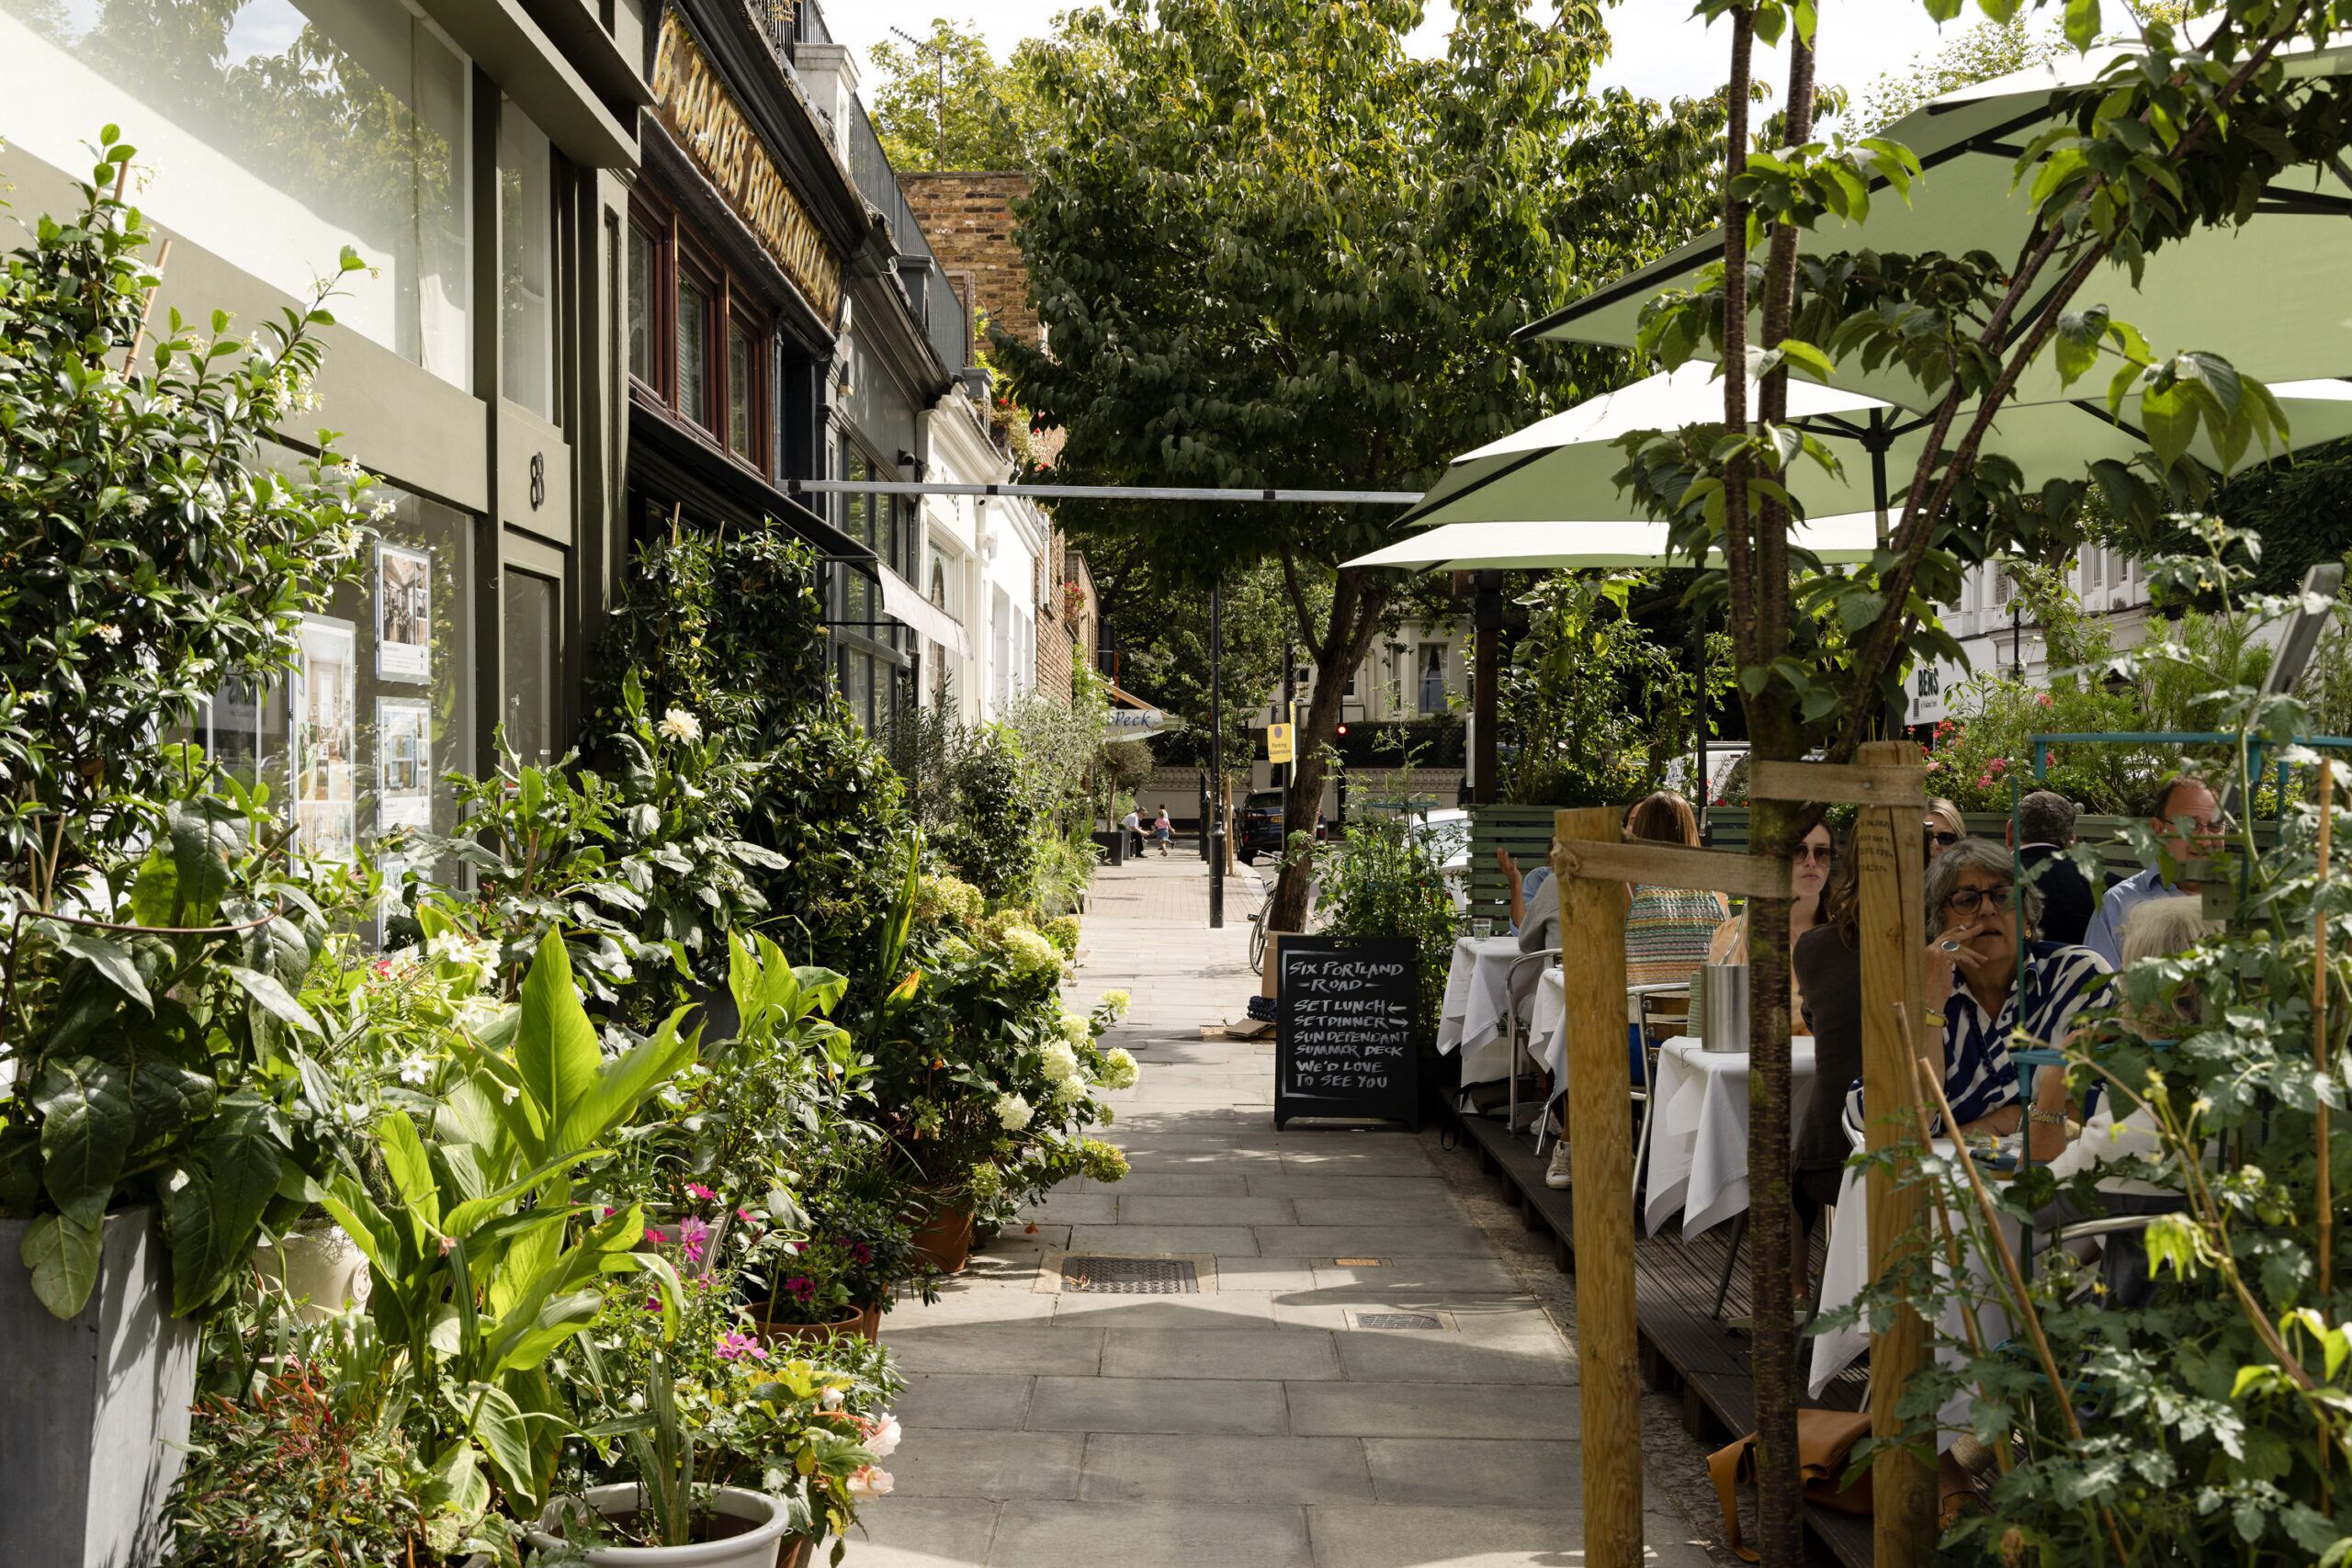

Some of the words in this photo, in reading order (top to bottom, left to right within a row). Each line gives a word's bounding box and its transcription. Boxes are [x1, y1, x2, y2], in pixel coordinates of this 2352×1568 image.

[675, 52, 749, 199] JAMES
[742, 142, 826, 310] BRICKNELL
[530, 451, 545, 513] 8
[1917, 667, 1939, 697] BENS
[1288, 961, 1317, 976] SIX
[1322, 961, 1404, 979] PORTLAND
[1310, 978, 1363, 993] ROAD
[1294, 999, 1333, 1013] SET
[1333, 999, 1386, 1016] LUNCH
[1294, 1015, 1329, 1027] SET
[1328, 1016, 1389, 1030] DINNER
[1294, 1031, 1325, 1043] SUN
[1294, 1044, 1361, 1058] SUMMER
[1364, 1045, 1404, 1057] DECK
[1295, 1059, 1340, 1073] WE'D
[1342, 1061, 1385, 1074] LOVE
[1295, 1074, 1315, 1088] TO
[1320, 1074, 1353, 1088] SEE
[1357, 1075, 1388, 1089] YOU
